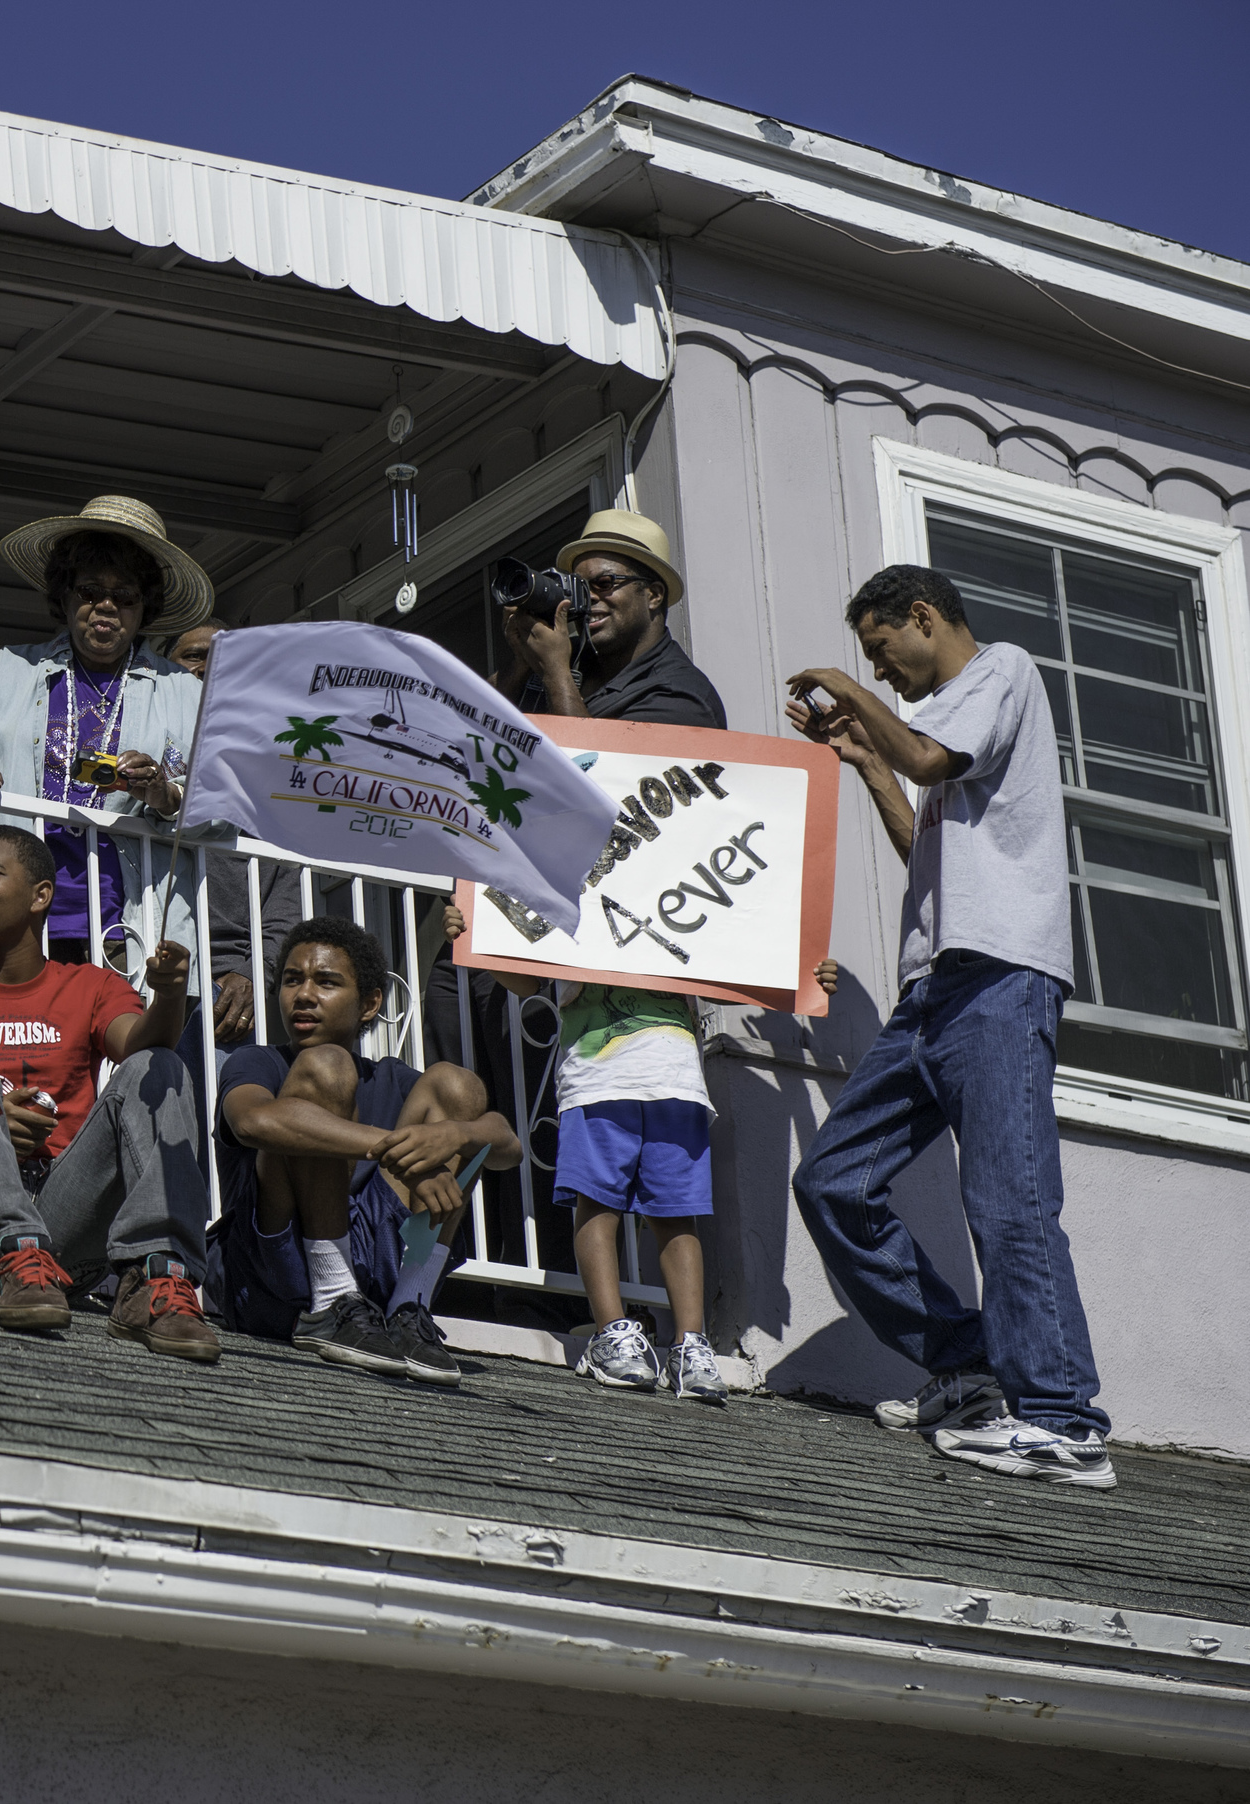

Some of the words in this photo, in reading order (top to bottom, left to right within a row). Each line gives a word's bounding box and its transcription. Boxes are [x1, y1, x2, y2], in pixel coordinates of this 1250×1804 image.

[309, 664, 432, 696] ENDEAVOUR'S
[429, 685, 480, 723] FINAL
[480, 712, 542, 759] FLIGHT
[466, 733, 519, 772] TO
[289, 765, 307, 789] LA
[313, 771, 469, 828] CALIFORNIA
[349, 811, 413, 838] 2012
